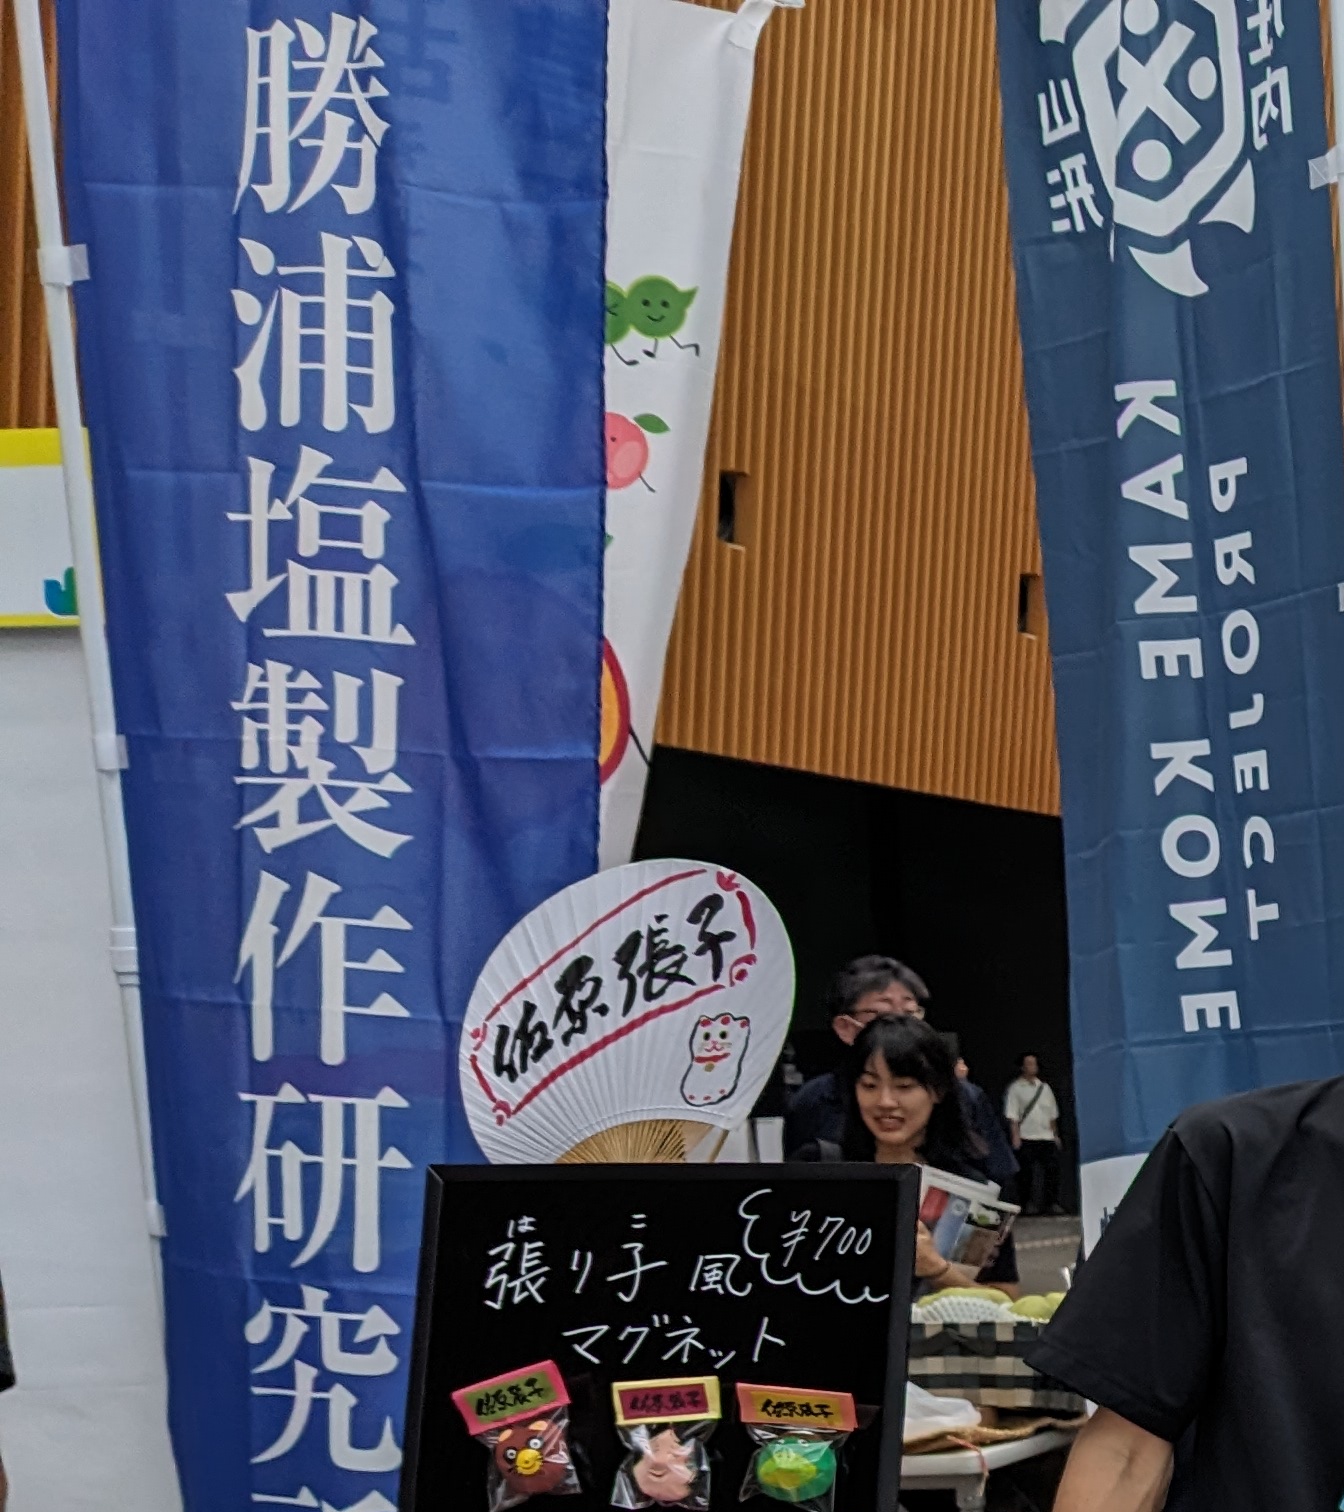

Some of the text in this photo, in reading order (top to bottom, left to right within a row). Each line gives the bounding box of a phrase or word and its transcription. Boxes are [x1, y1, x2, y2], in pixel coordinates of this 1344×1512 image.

[492, 893, 737, 1082] 佐原張子
[562, 1313, 786, 1369] マグネット
